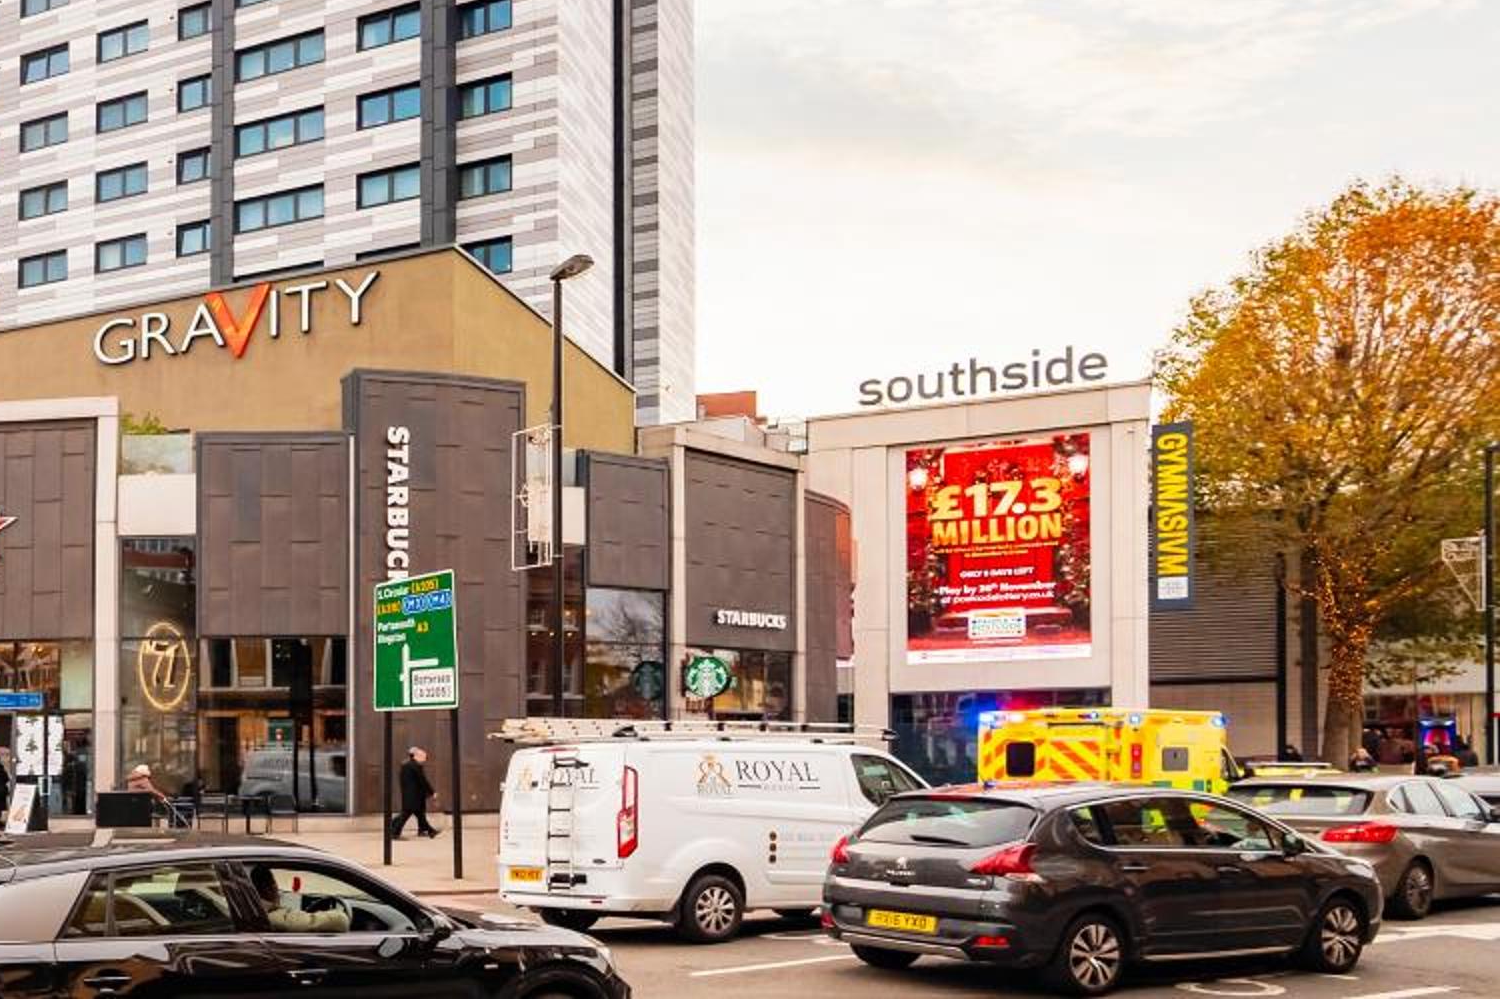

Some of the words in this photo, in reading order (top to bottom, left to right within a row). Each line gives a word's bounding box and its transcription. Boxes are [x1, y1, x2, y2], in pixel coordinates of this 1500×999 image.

[94, 271, 380, 365] GRAVITY
[858, 345, 1108, 406] southside
[387, 426, 410, 582] STARBUC
[928, 477, 1063, 521] £17.3
[931, 512, 1063, 547] MILLION
[963, 584, 977, 597] by
[1000, 581, 1057, 591] November
[716, 609, 787, 629] STARBUCKS
[735, 760, 820, 782] ROYAL
